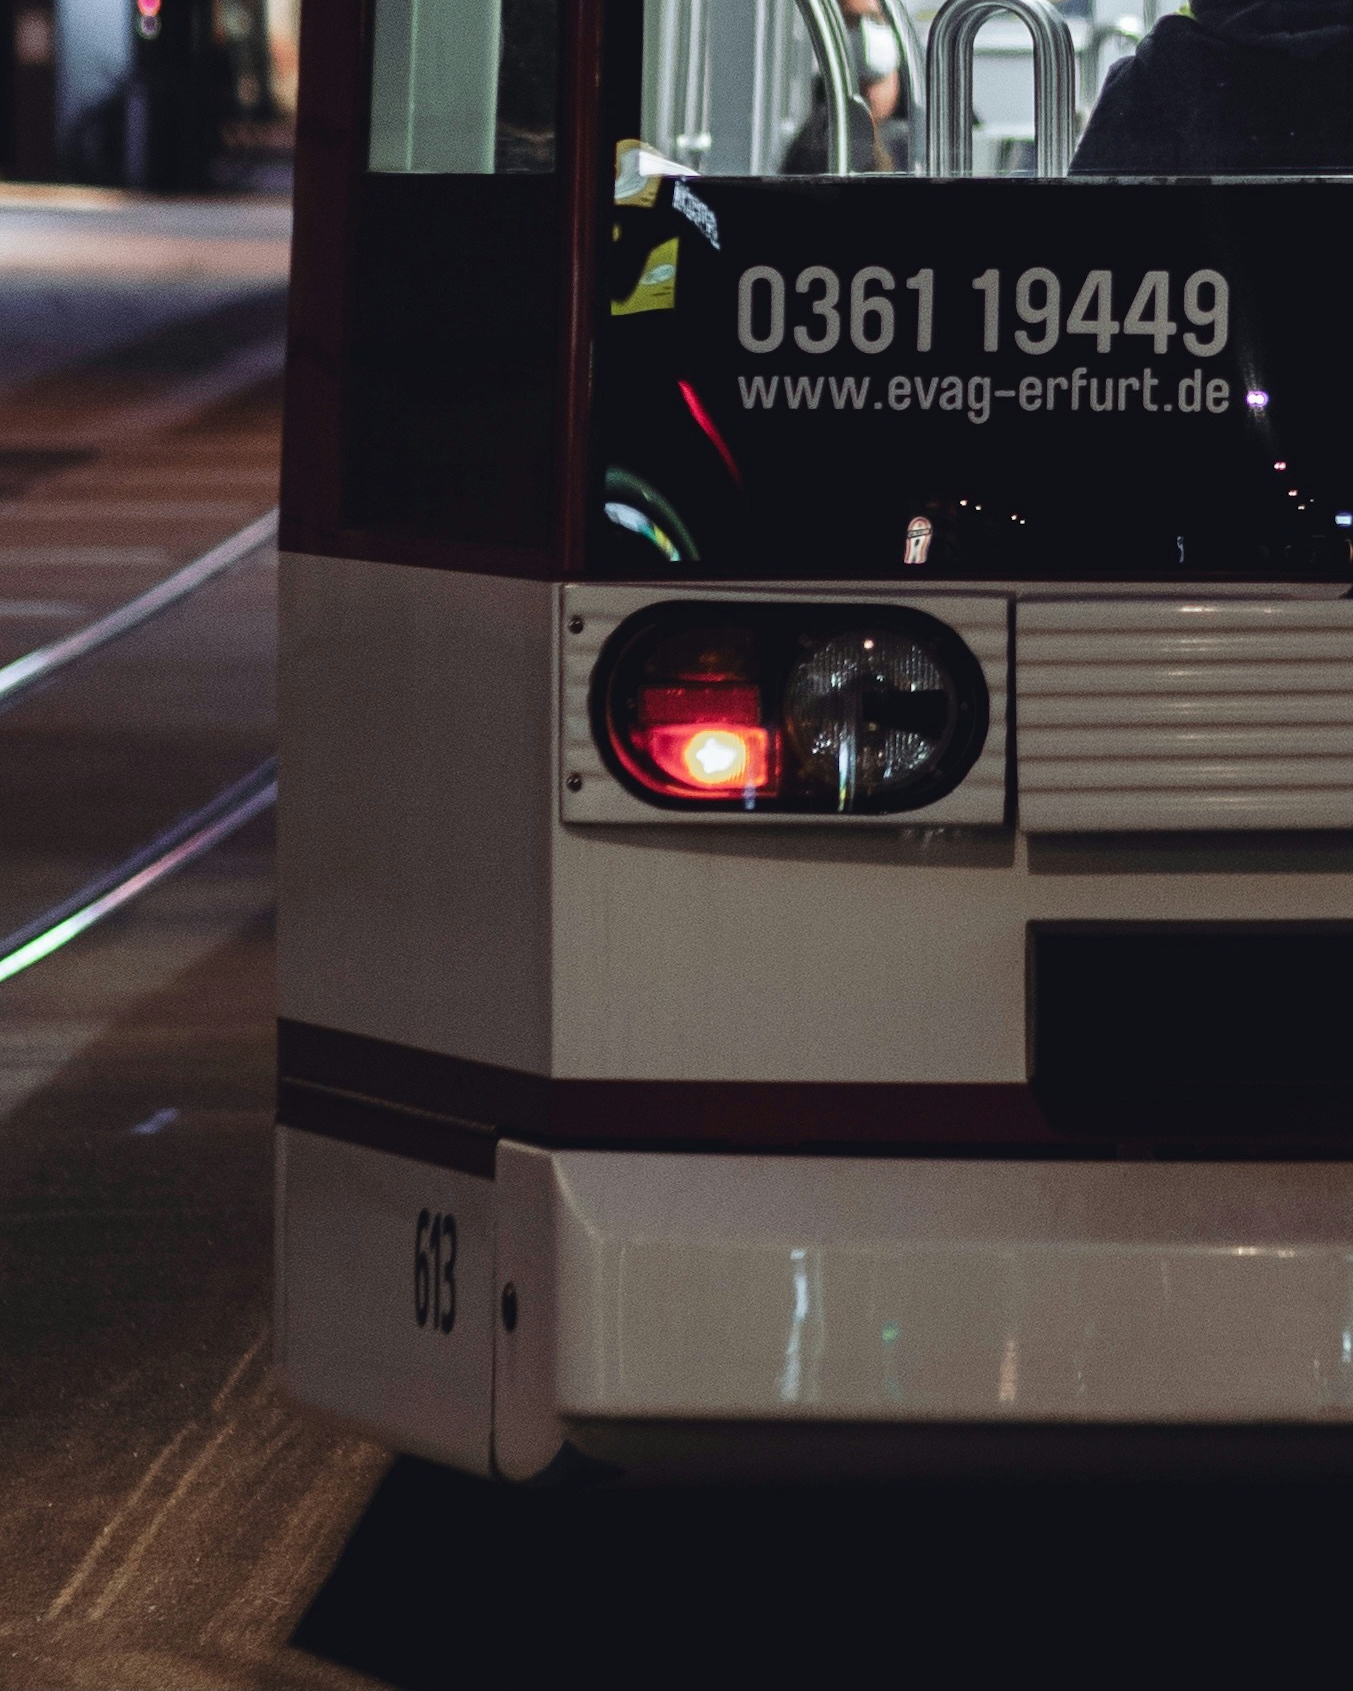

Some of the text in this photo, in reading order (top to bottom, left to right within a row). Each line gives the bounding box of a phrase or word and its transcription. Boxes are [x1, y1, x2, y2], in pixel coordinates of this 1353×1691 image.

[738, 265, 1230, 358] 0361 19449
[738, 366, 1231, 425] www.evag-erfurt.de
[414, 1208, 458, 1335] 613
